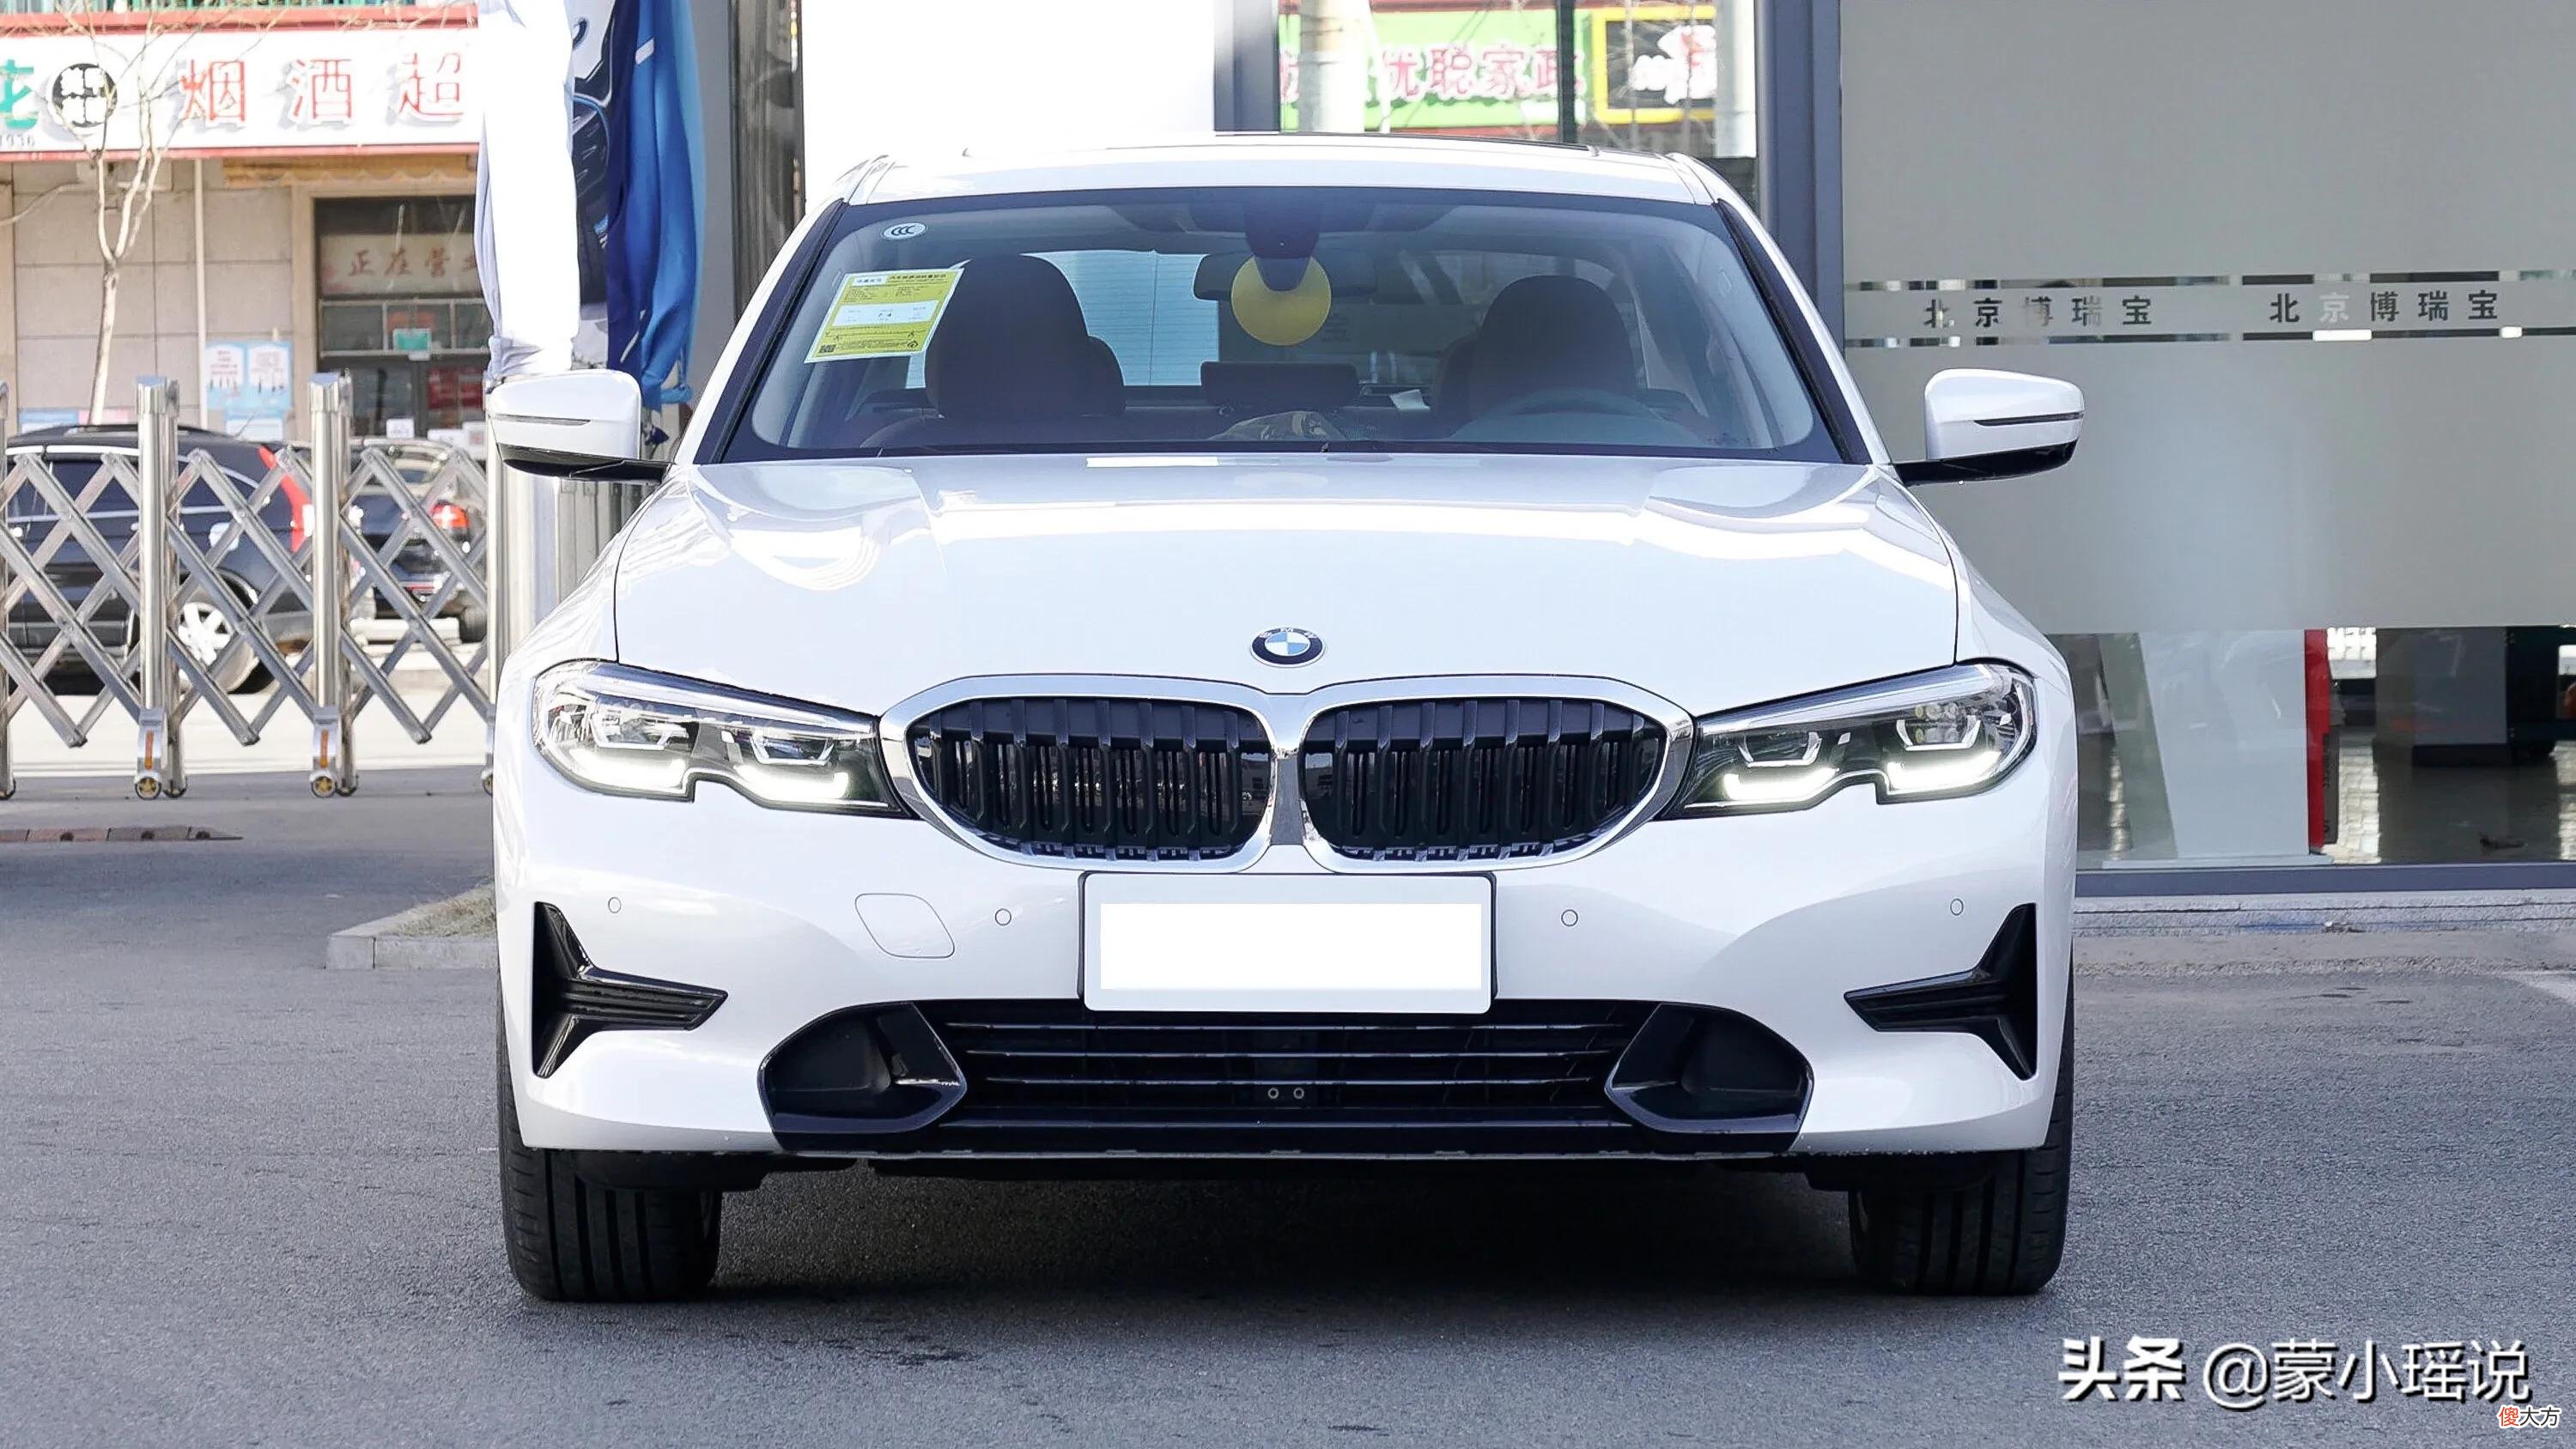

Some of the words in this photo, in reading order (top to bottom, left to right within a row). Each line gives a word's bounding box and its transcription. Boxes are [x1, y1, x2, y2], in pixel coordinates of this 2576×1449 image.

[2269, 290, 2498, 324] 北京博瑞宝
